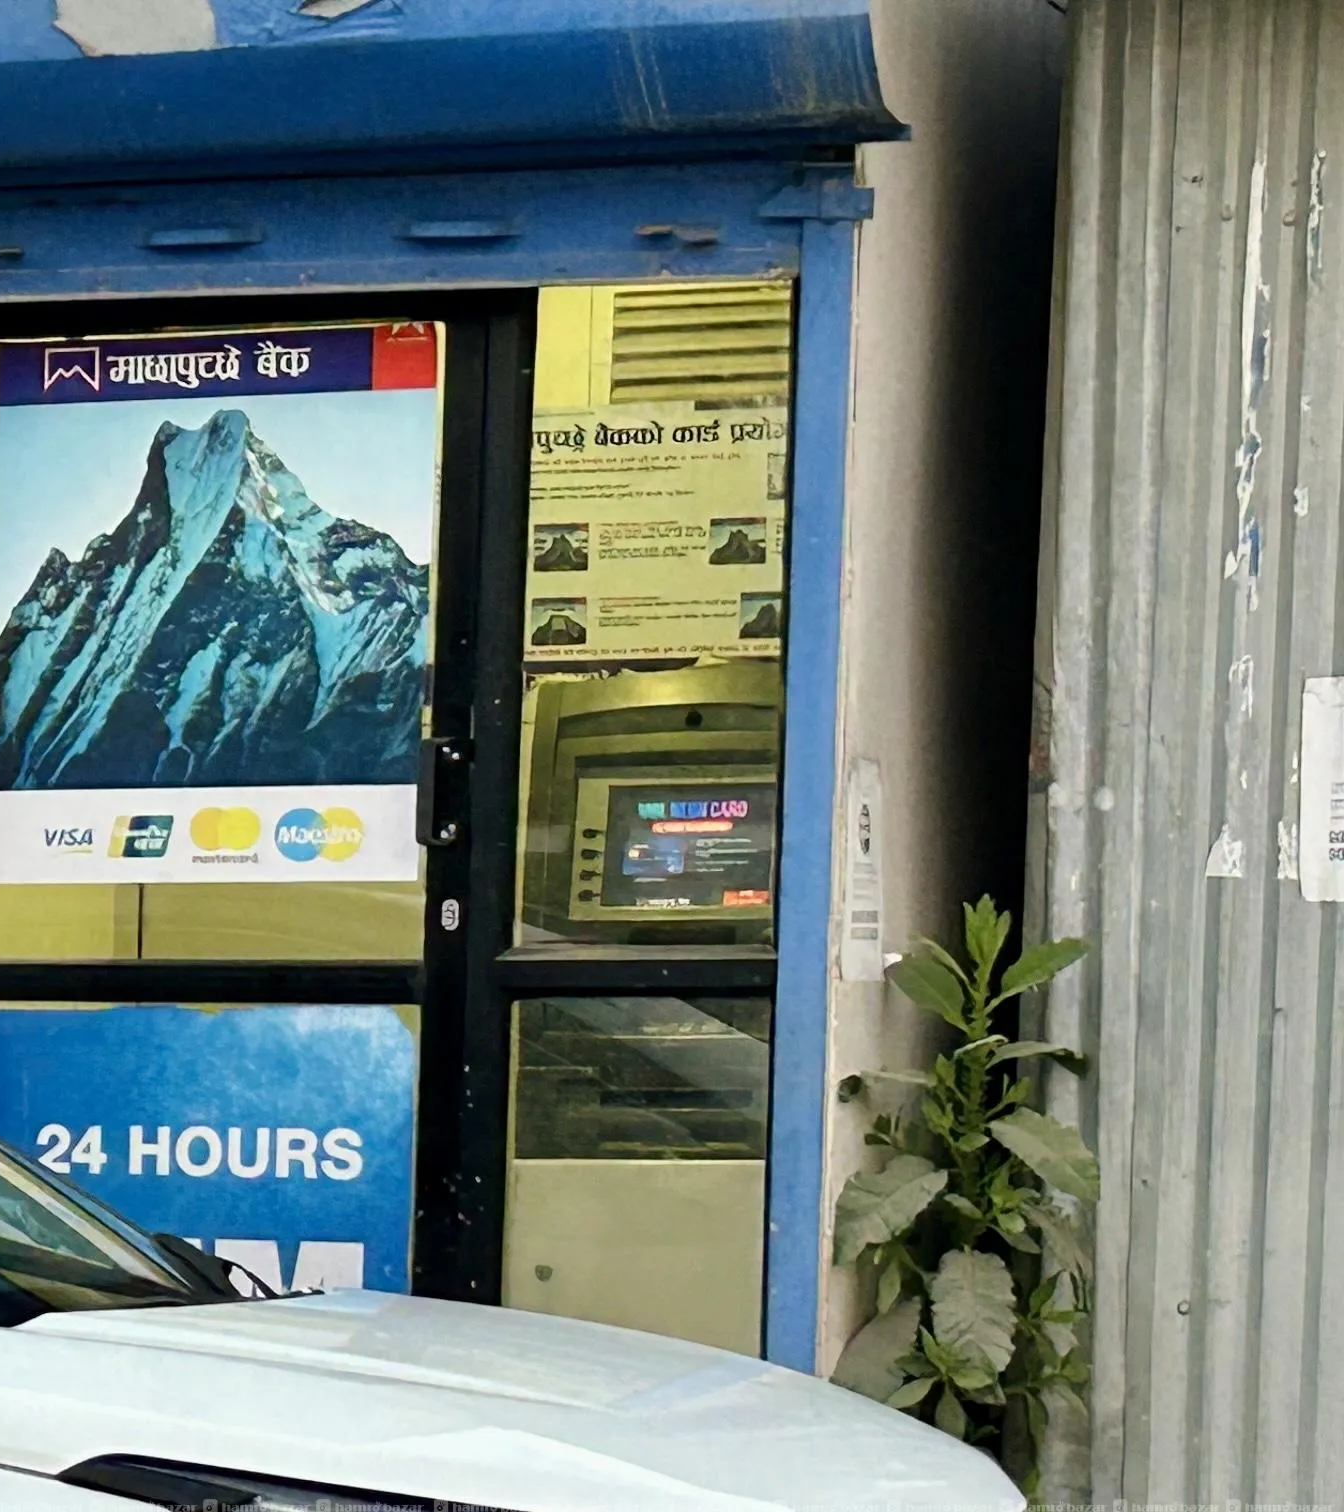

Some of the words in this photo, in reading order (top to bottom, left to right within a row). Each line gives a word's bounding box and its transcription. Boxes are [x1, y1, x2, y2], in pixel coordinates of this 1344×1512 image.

[44, 828, 94, 848] VISA
[35, 1123, 108, 1175] 24
[128, 1125, 364, 1181] HOURS
